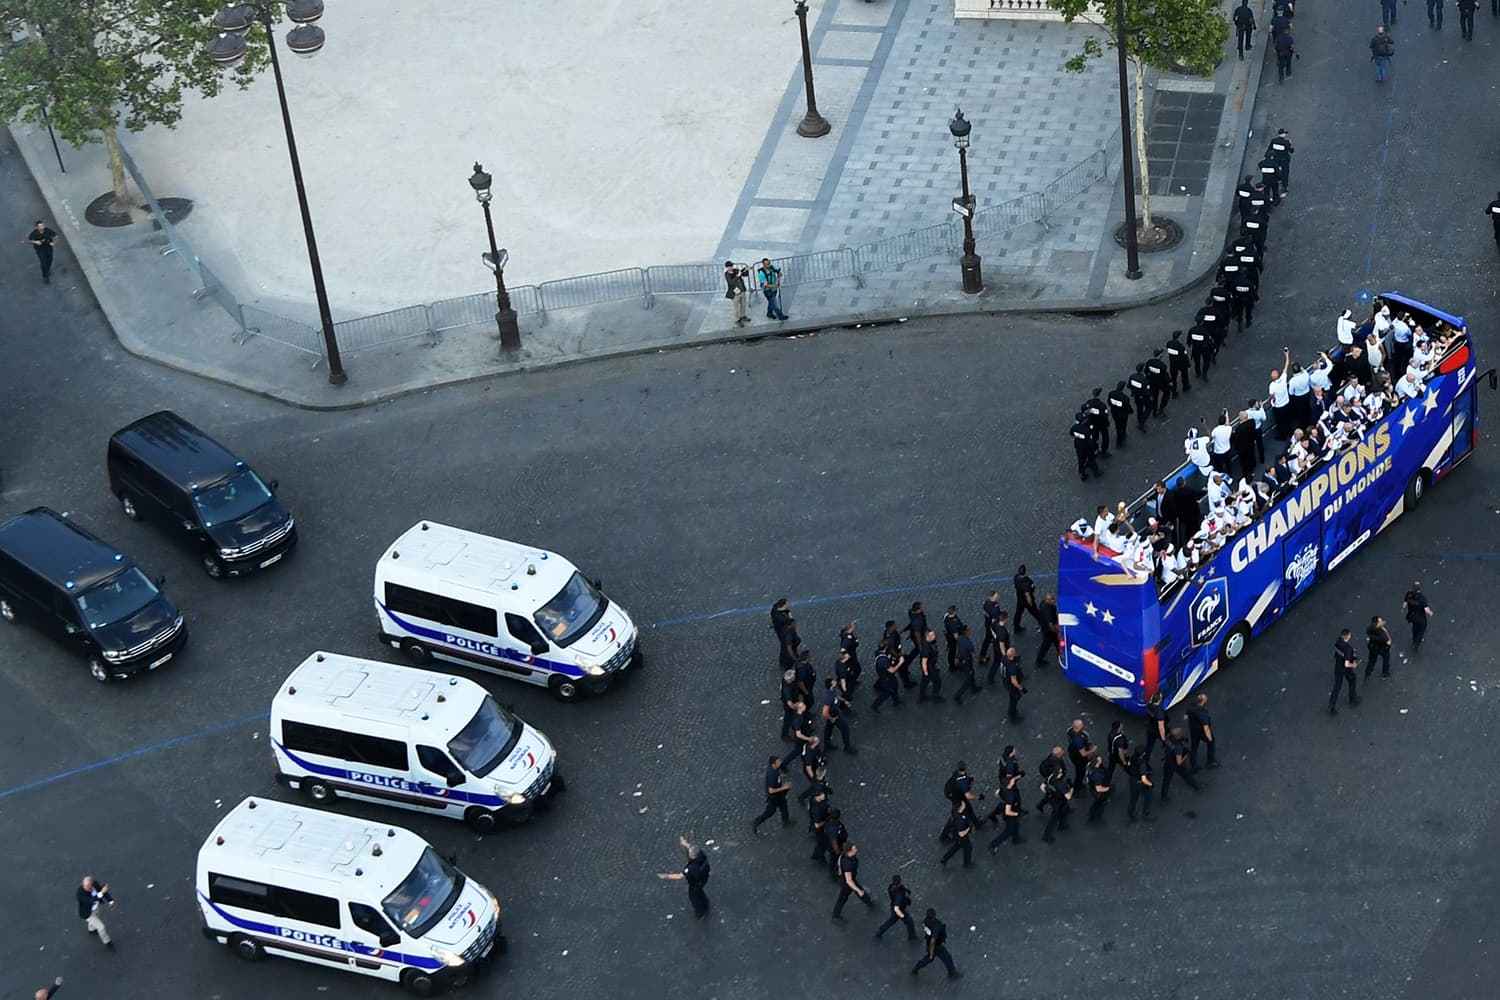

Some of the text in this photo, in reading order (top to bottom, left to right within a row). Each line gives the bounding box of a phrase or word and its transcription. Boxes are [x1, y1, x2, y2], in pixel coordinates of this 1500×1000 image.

[1231, 422, 1391, 573] CHAMPIONS
[1324, 455, 1393, 522] DU MONDE
[1197, 615, 1223, 641] FRANCE
[446, 634, 499, 656] POLICE
[351, 771, 409, 790] POLICE
[281, 927, 342, 949] POLICE
